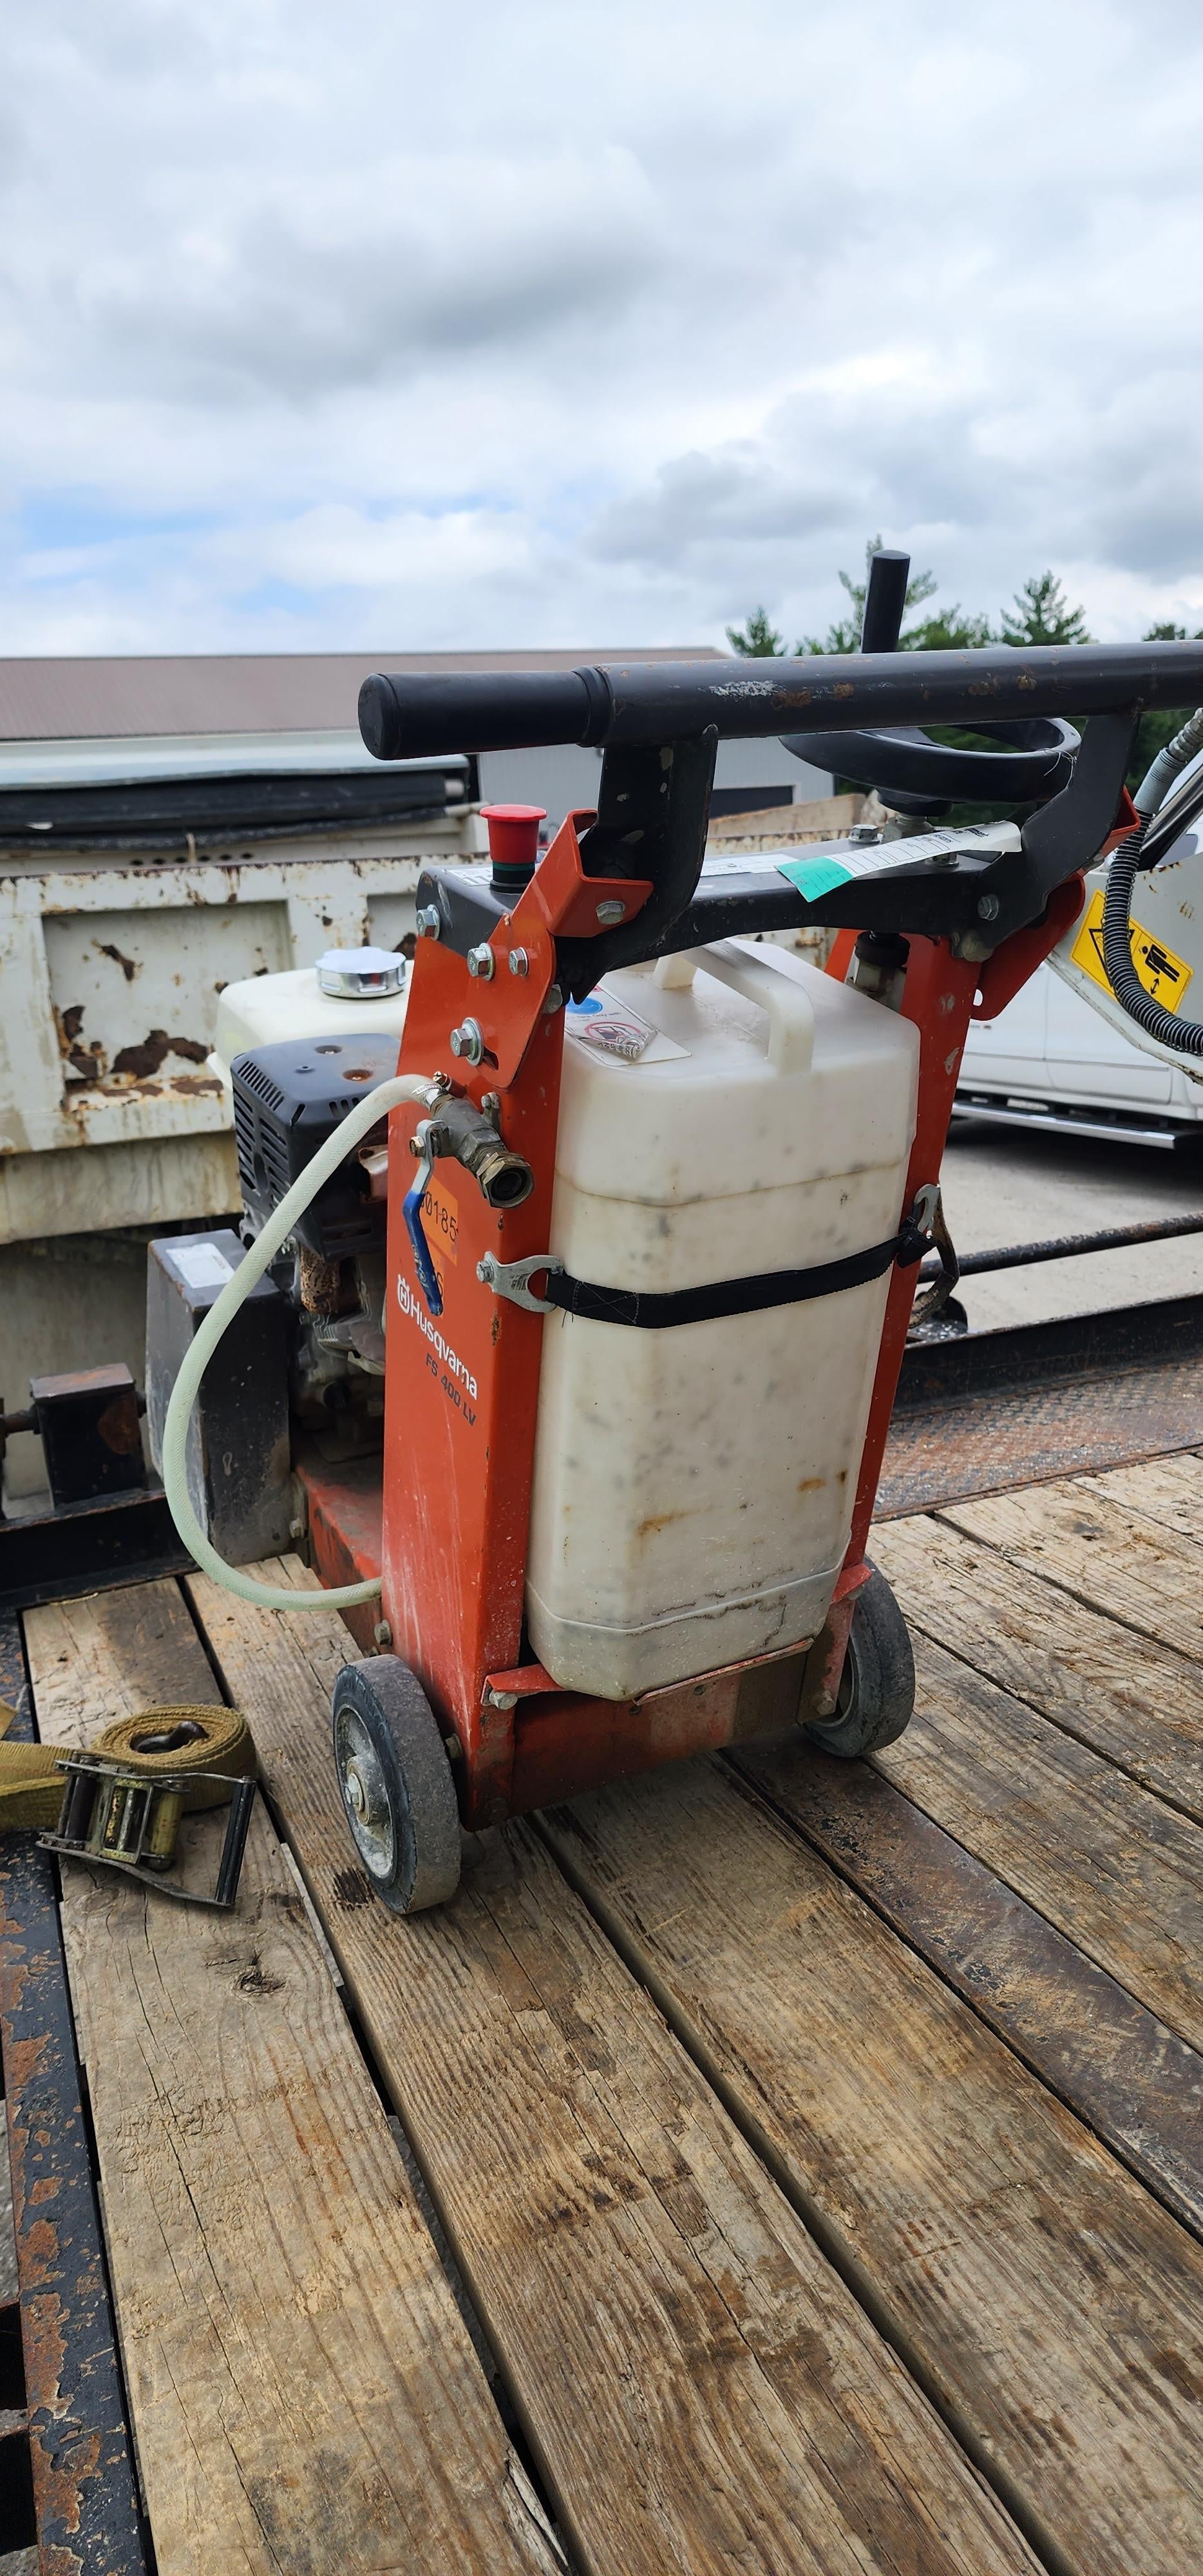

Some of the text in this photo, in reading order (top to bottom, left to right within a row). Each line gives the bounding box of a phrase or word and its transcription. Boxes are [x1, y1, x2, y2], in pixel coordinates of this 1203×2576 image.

[410, 1294, 477, 1401] Husqvarna
[426, 1353, 477, 1426] FS 400 LV
